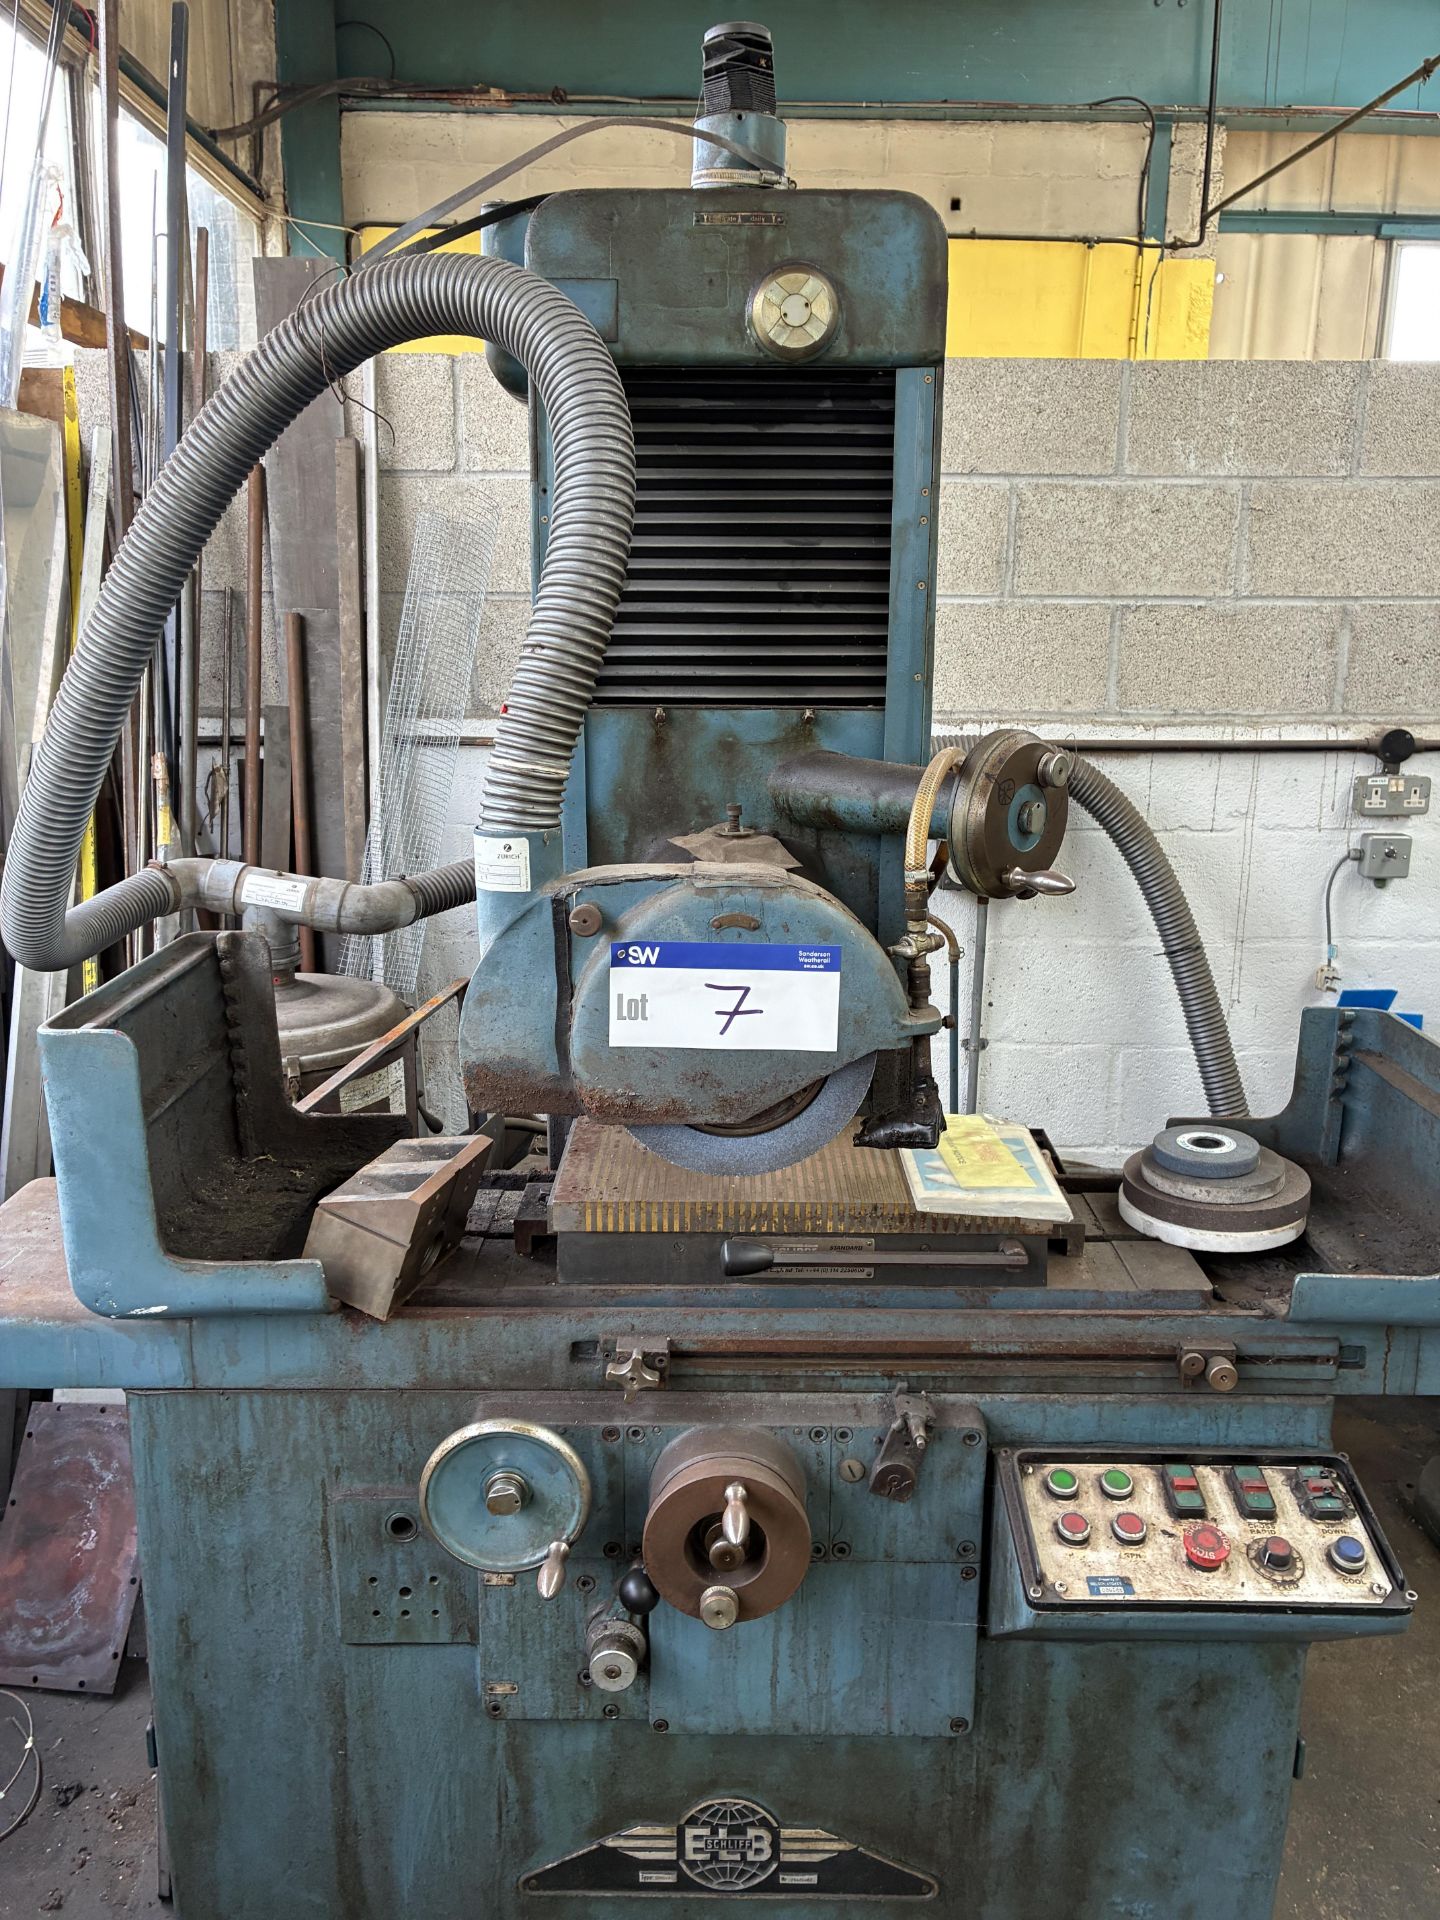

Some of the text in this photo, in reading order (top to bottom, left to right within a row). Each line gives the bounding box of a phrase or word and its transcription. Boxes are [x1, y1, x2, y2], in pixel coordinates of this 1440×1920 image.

[628, 946, 660, 965] SW
[616, 993, 649, 1021] Lot
[704, 983, 764, 1035] 7
[1342, 1577, 1367, 1585] COOL
[684, 1825, 773, 1862] ELB
[706, 1839, 752, 1850] SCHLIFF
